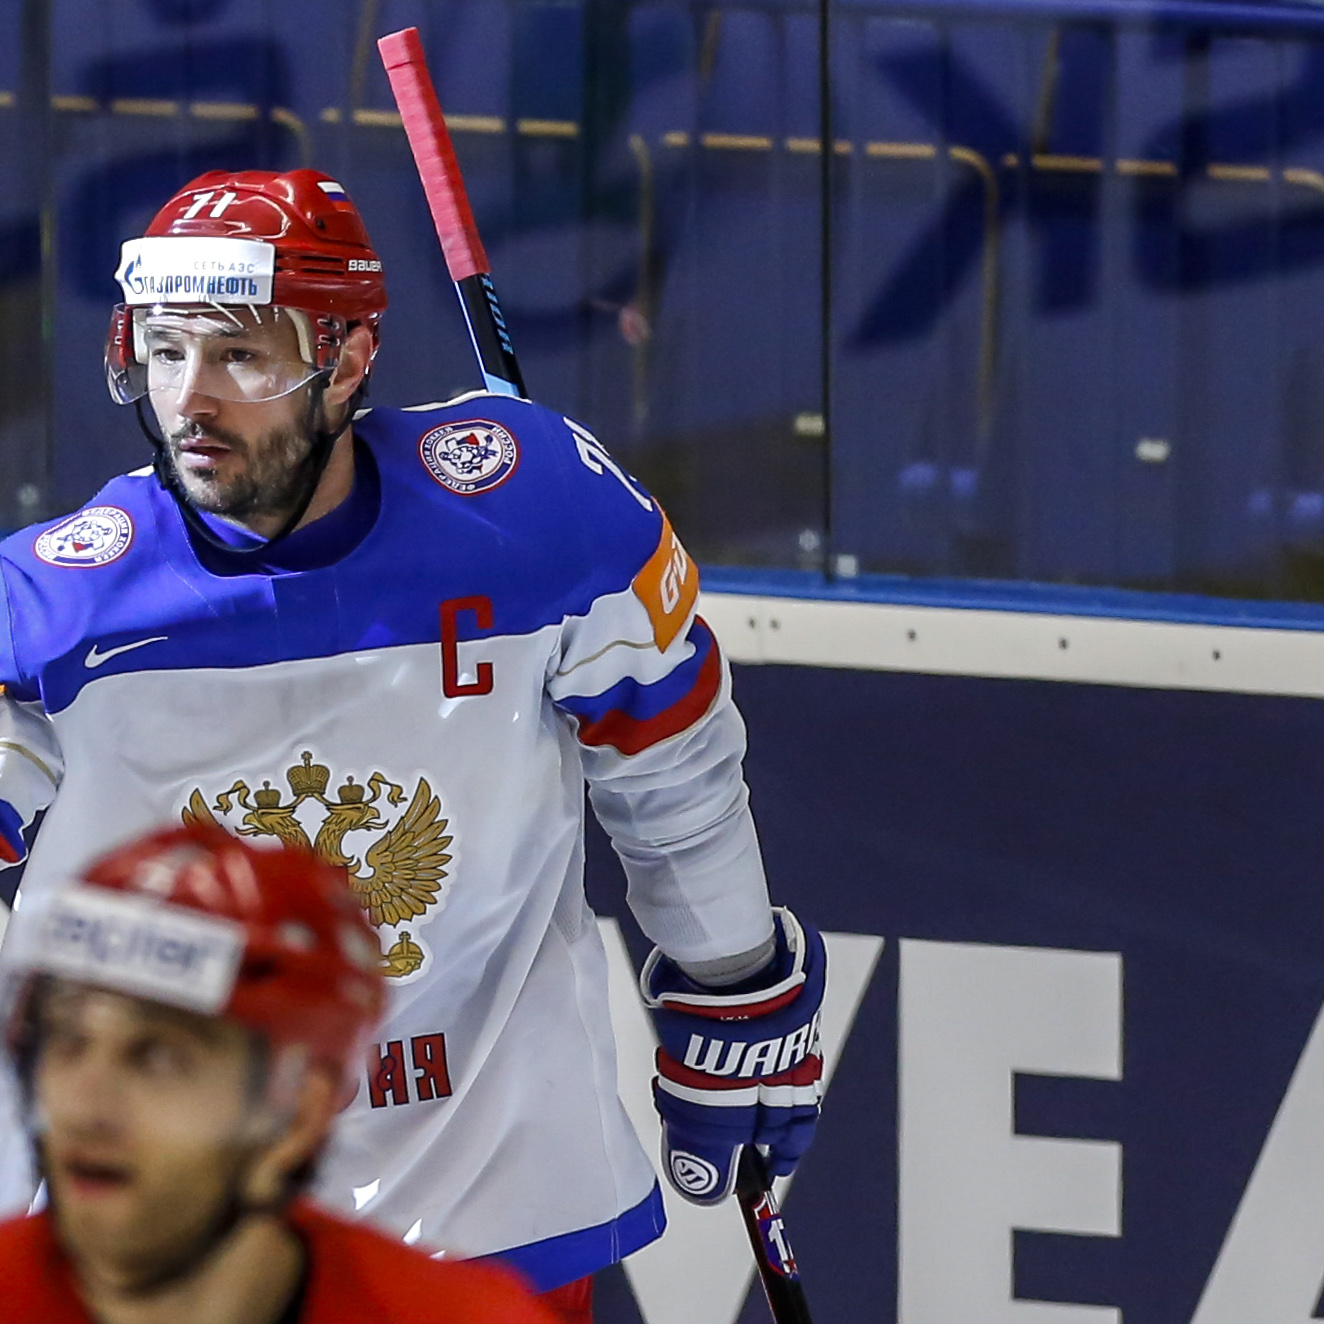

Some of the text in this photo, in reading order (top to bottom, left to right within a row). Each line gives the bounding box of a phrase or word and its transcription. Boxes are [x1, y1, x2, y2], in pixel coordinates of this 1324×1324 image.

[184, 191, 238, 220] 71
[193, 260, 256, 274] СЕТЬ АЗС
[142, 275, 258, 297] ГАЗПРОМНЕФТЬ
[438, 595, 494, 699] C
